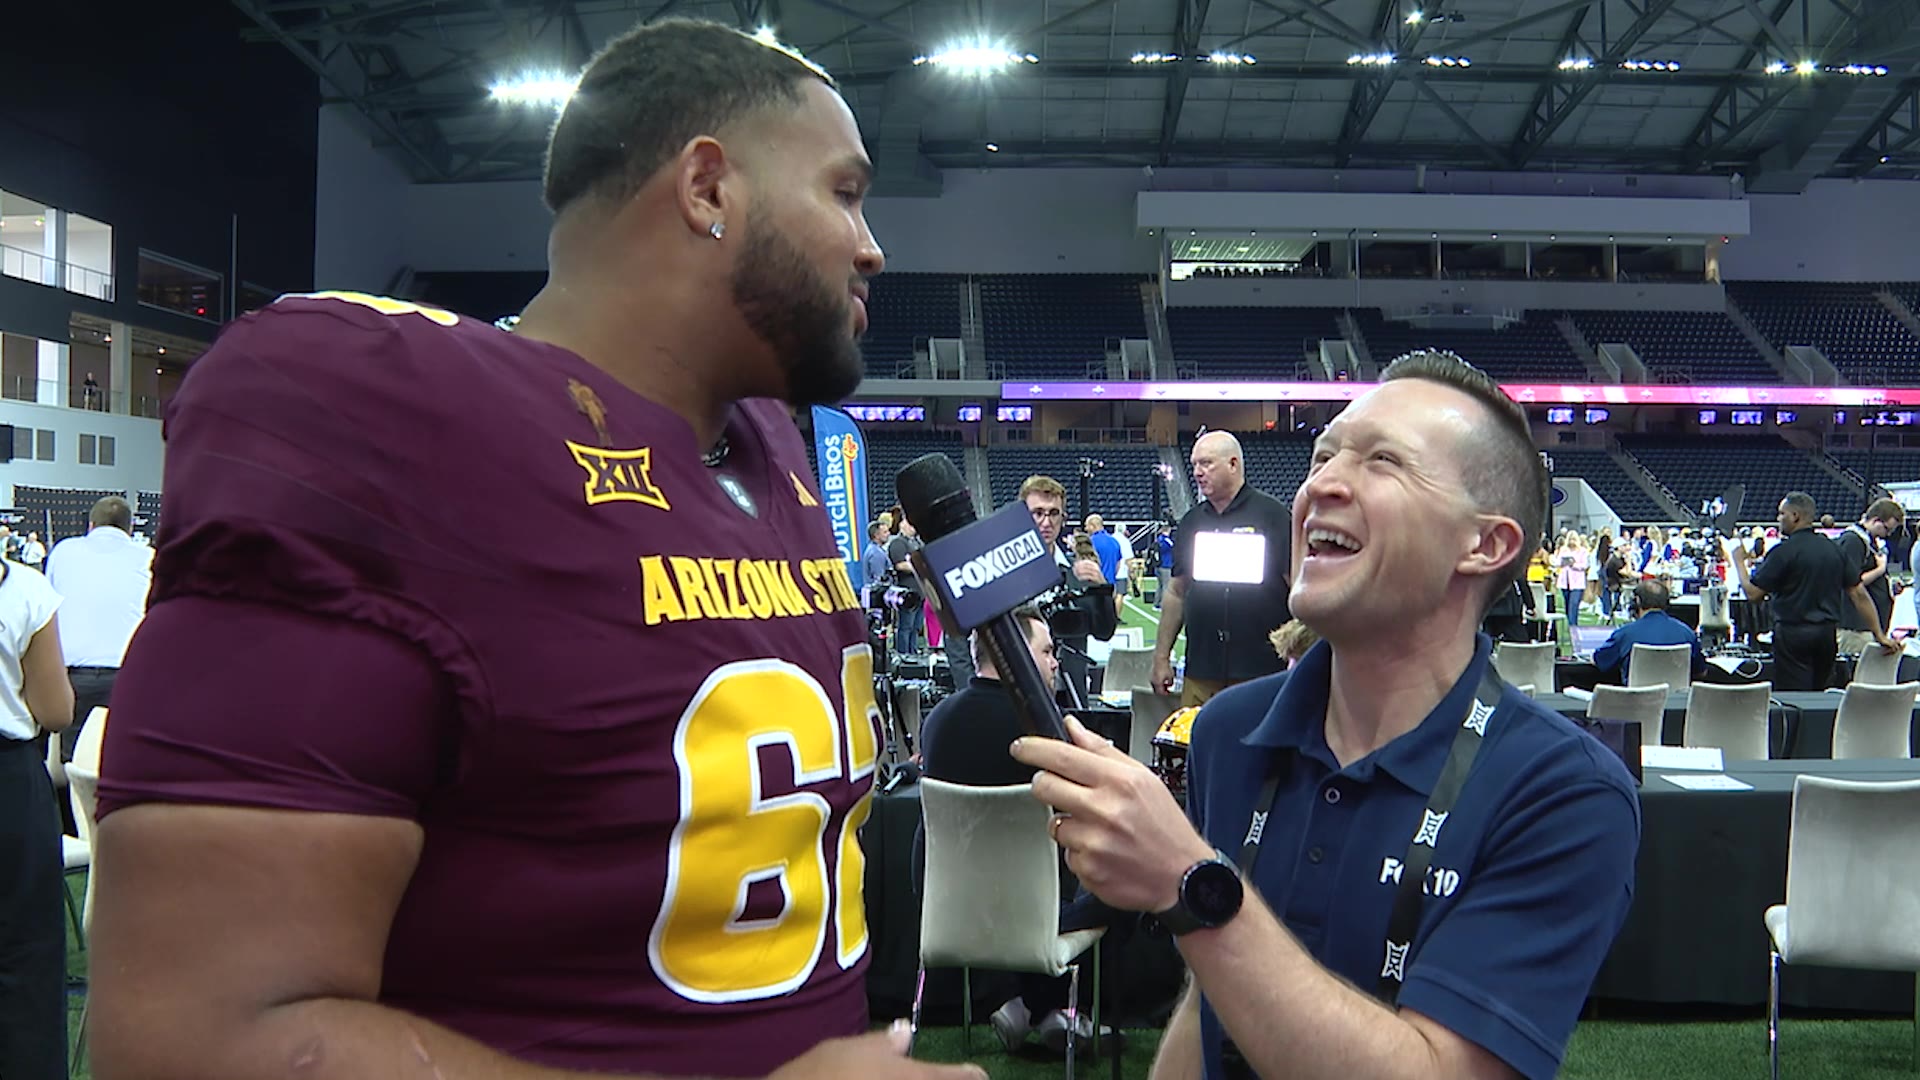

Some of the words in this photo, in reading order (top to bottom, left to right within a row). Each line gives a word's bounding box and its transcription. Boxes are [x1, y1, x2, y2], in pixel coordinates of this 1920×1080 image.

[574, 447, 662, 503] XII
[824, 434, 845, 491] BROS
[826, 493, 851, 563] DUTCH
[639, 556, 815, 626] ARIZONA
[944, 551, 1002, 599] FOX
[997, 532, 1043, 571] LOCAL
[1433, 868, 1461, 897] 10
